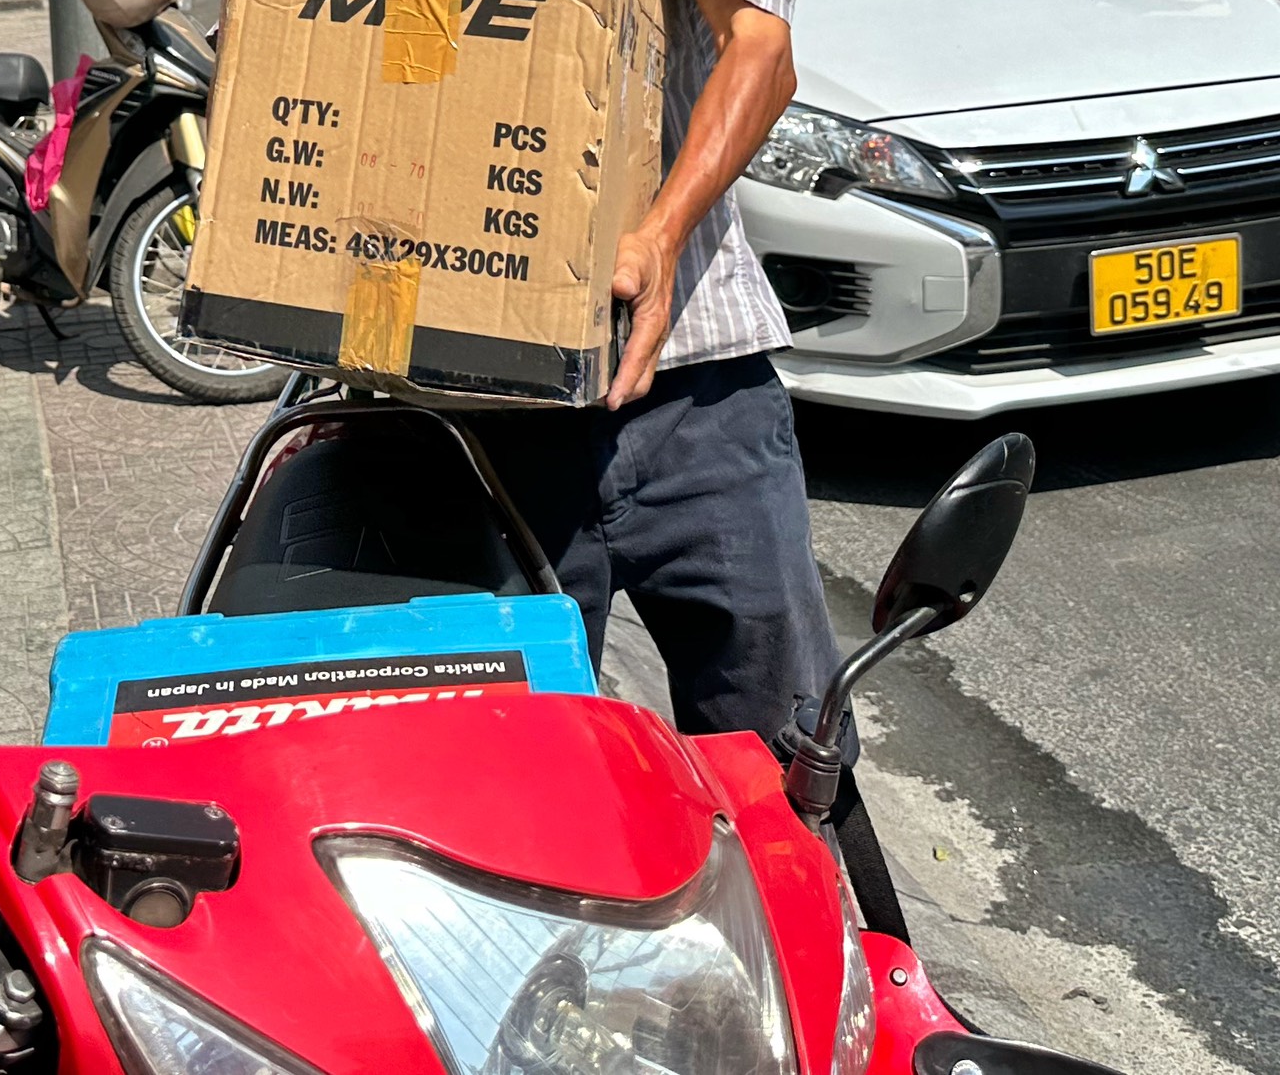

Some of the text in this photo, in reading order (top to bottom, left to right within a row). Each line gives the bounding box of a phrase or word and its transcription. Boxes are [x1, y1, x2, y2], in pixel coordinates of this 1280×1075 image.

[272, 95, 340, 128] Q'TY:
[266, 136, 325, 168] G.W:
[493, 122, 548, 153] PCS
[260, 177, 320, 210] N.W:
[487, 165, 543, 196] KGS
[483, 207, 540, 239] KGS
[254, 218, 530, 282] MEAS: 46X29X30CM
[1133, 247, 1197, 286] 50E
[1108, 281, 1224, 327] 059.49
[241, 671, 299, 689] Made
[304, 664, 429, 686] Corporation
[434, 660, 506, 677] Makita
[147, 680, 210, 700] Japan
